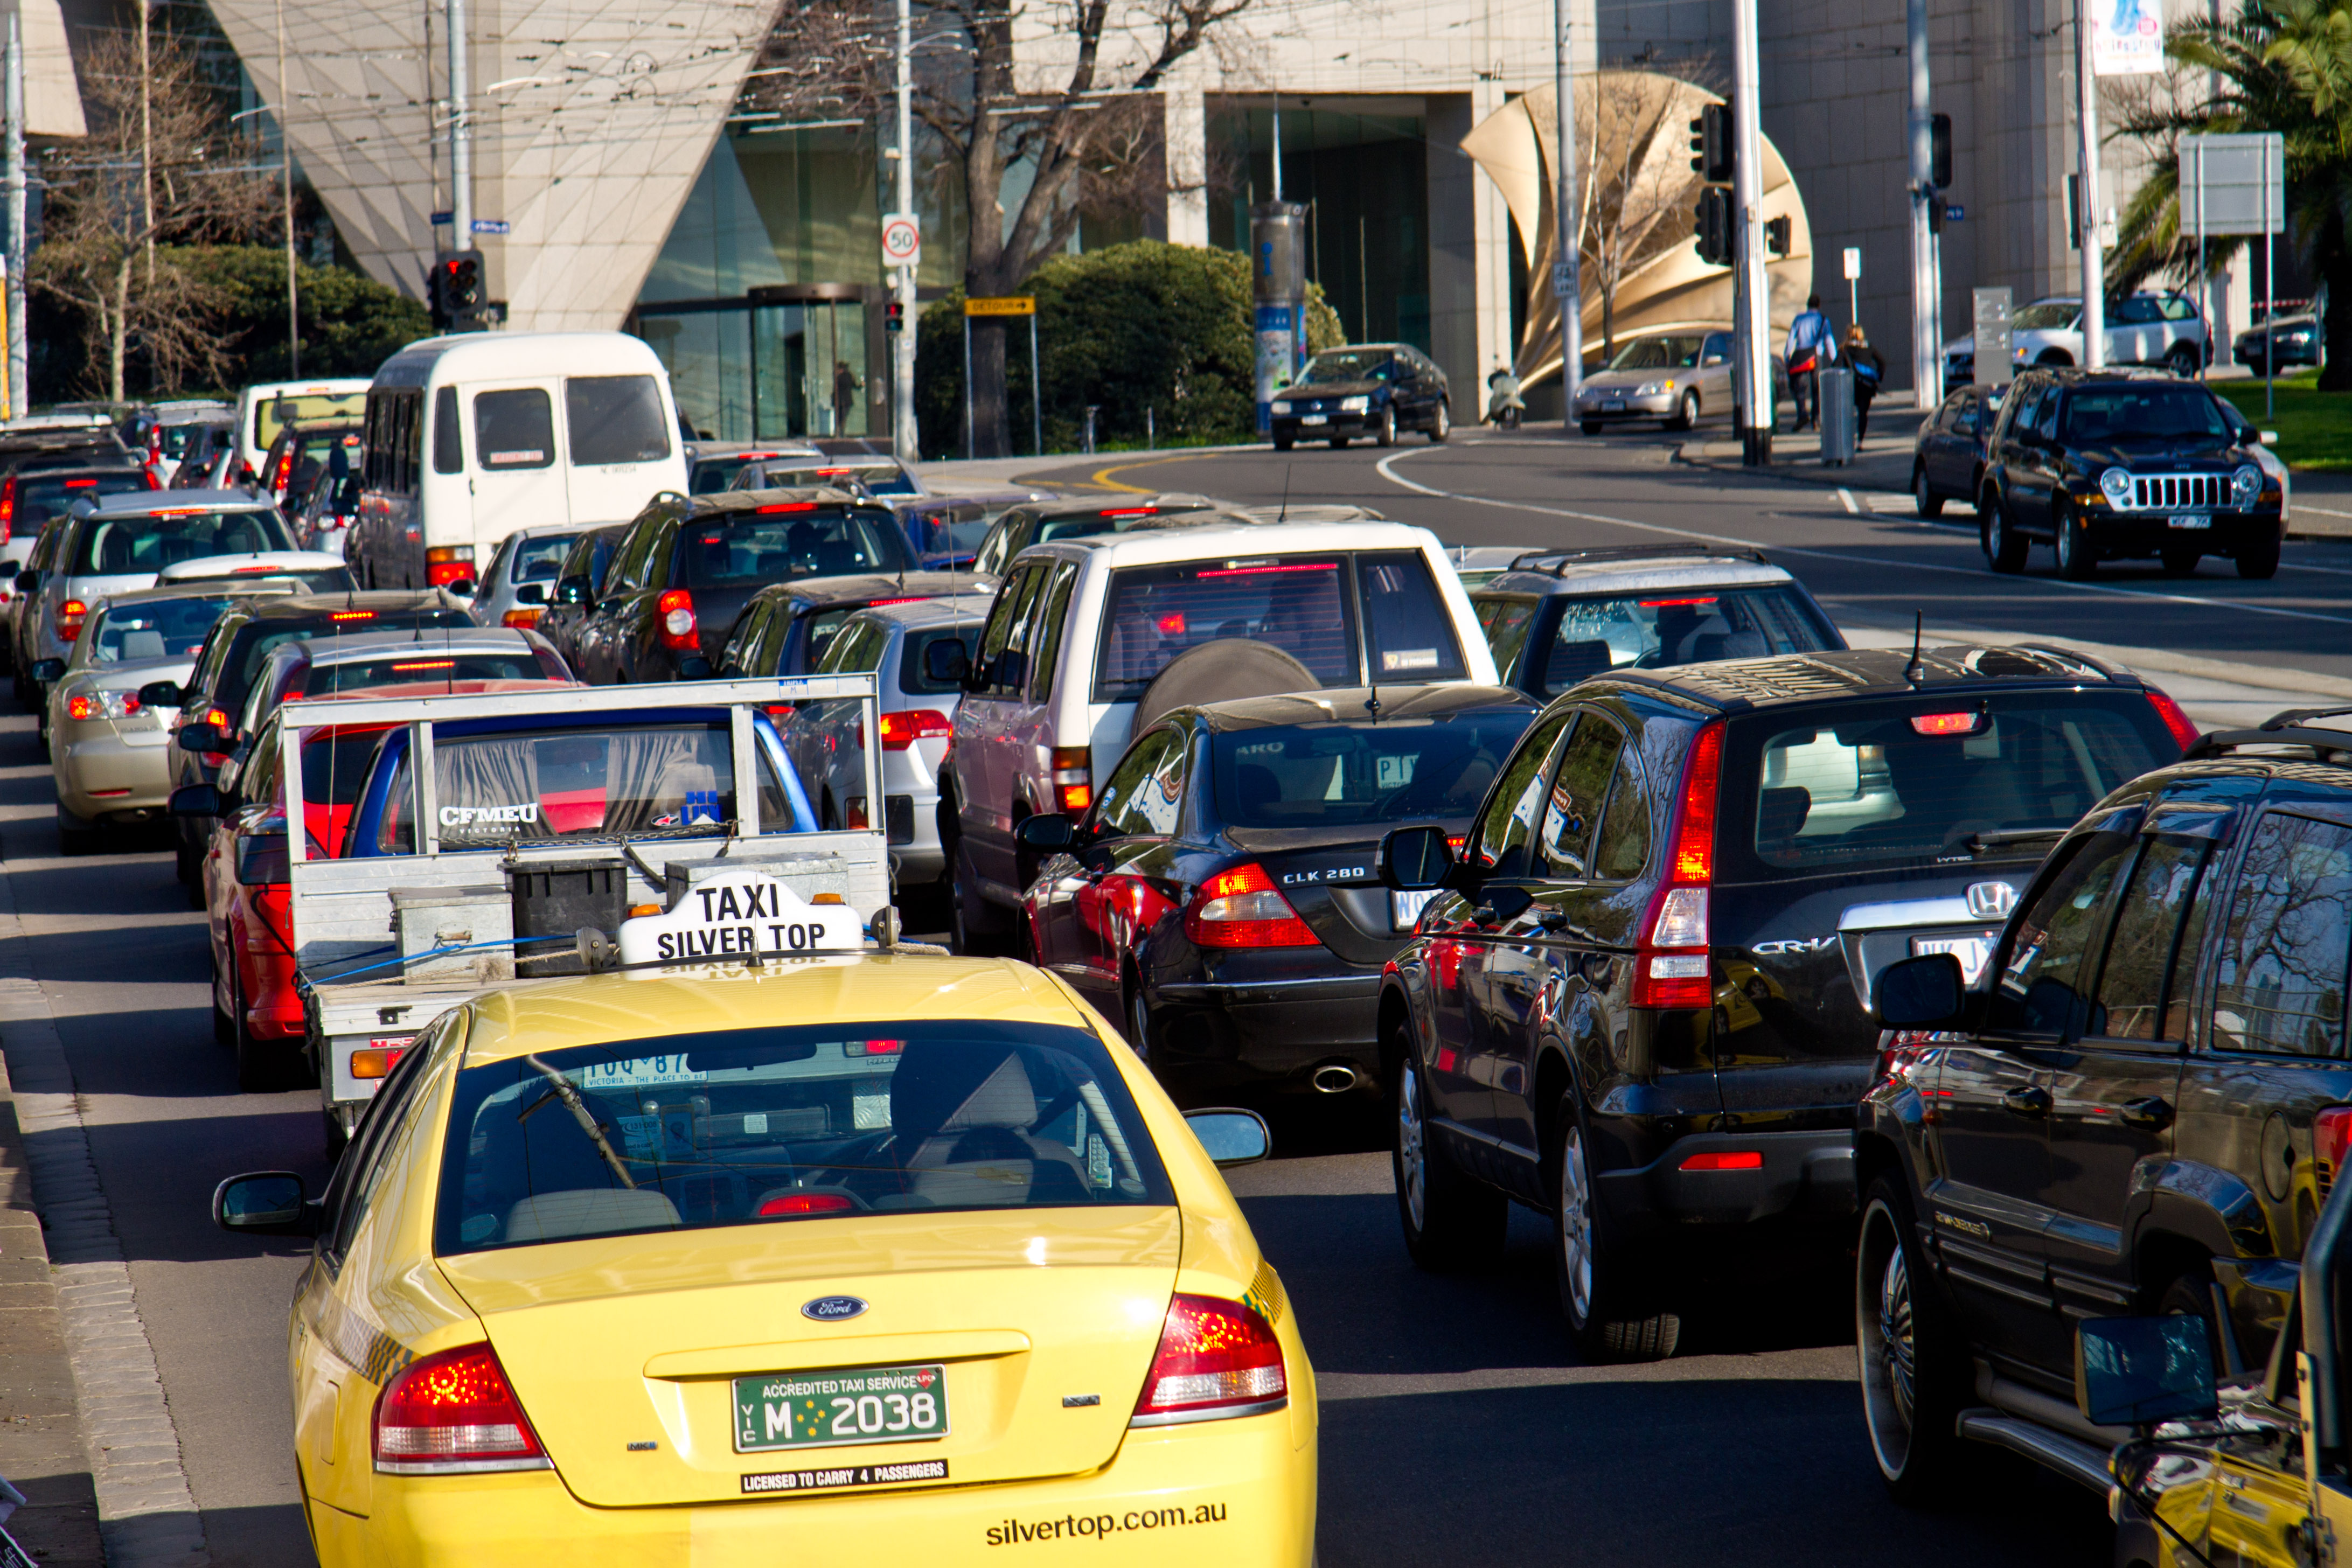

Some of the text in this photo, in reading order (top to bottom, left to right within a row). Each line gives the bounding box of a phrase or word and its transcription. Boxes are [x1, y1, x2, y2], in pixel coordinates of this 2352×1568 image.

[891, 232, 913, 248] 50
[972, 301, 1013, 311] DETOUR
[440, 803, 538, 826] CFMEU
[1283, 867, 1365, 884] CLK 280
[696, 883, 779, 922] TAXI
[658, 923, 825, 959] SILVER TOP
[589, 1078, 624, 1086] VICTORIA
[819, 1300, 852, 1315] Ford
[763, 1376, 917, 1398] ACCREDITED TAXI SERVICE
[764, 1392, 937, 1440] M 2038
[743, 1462, 944, 1491] LICENSED TO CARRY 4 PASSENGERS
[986, 1502, 1227, 1545] silvertop.com.au
